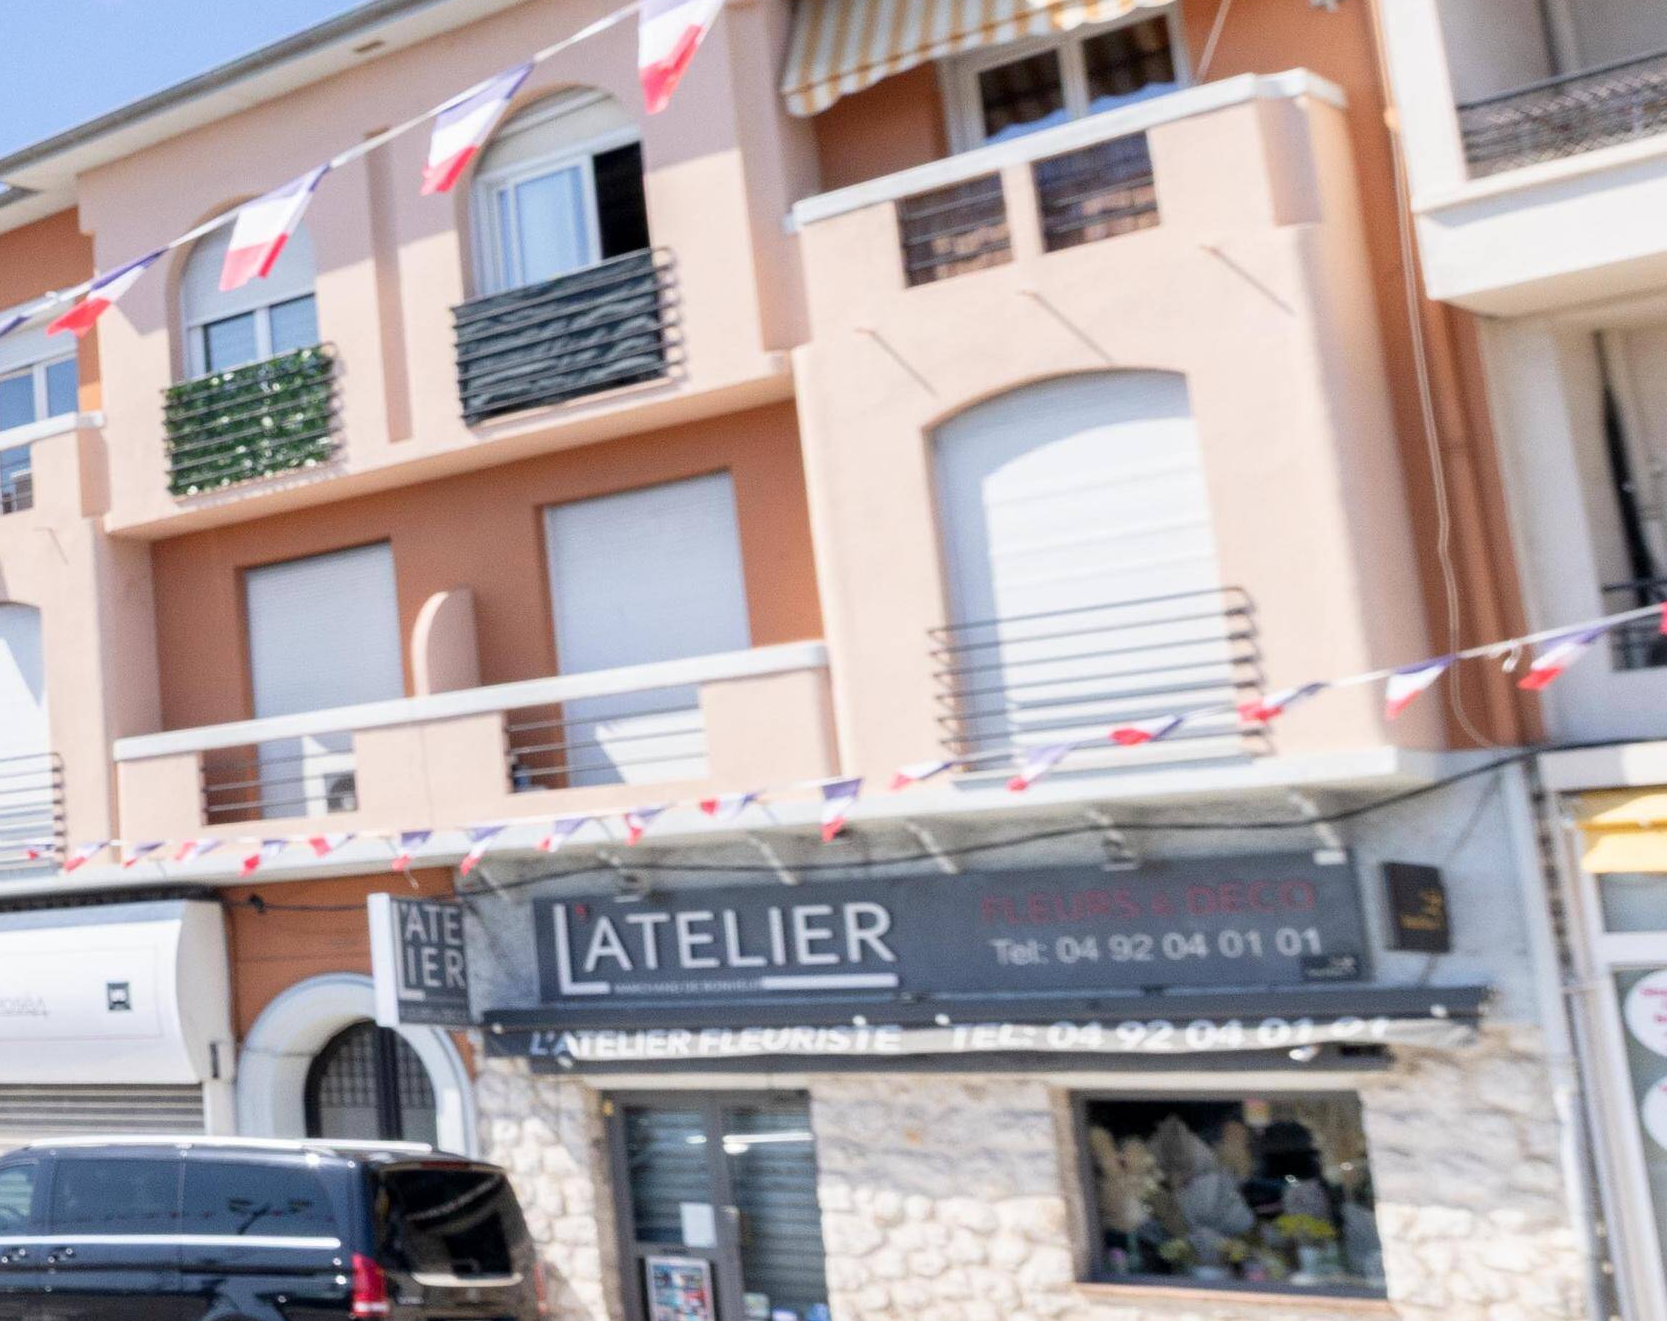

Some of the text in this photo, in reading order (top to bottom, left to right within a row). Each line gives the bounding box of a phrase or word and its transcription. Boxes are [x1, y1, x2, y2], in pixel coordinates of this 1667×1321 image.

[981, 888, 1141, 926] FLEURS
[989, 927, 1322, 966] Tel: 04 92 04 01 01
[530, 1027, 692, 1060] L'ATELIER
[698, 1023, 903, 1055] FLEURISTE
[1047, 1021, 1104, 1049] 04
[1114, 1020, 1176, 1049] 92
[1185, 1019, 1244, 1048] 04
